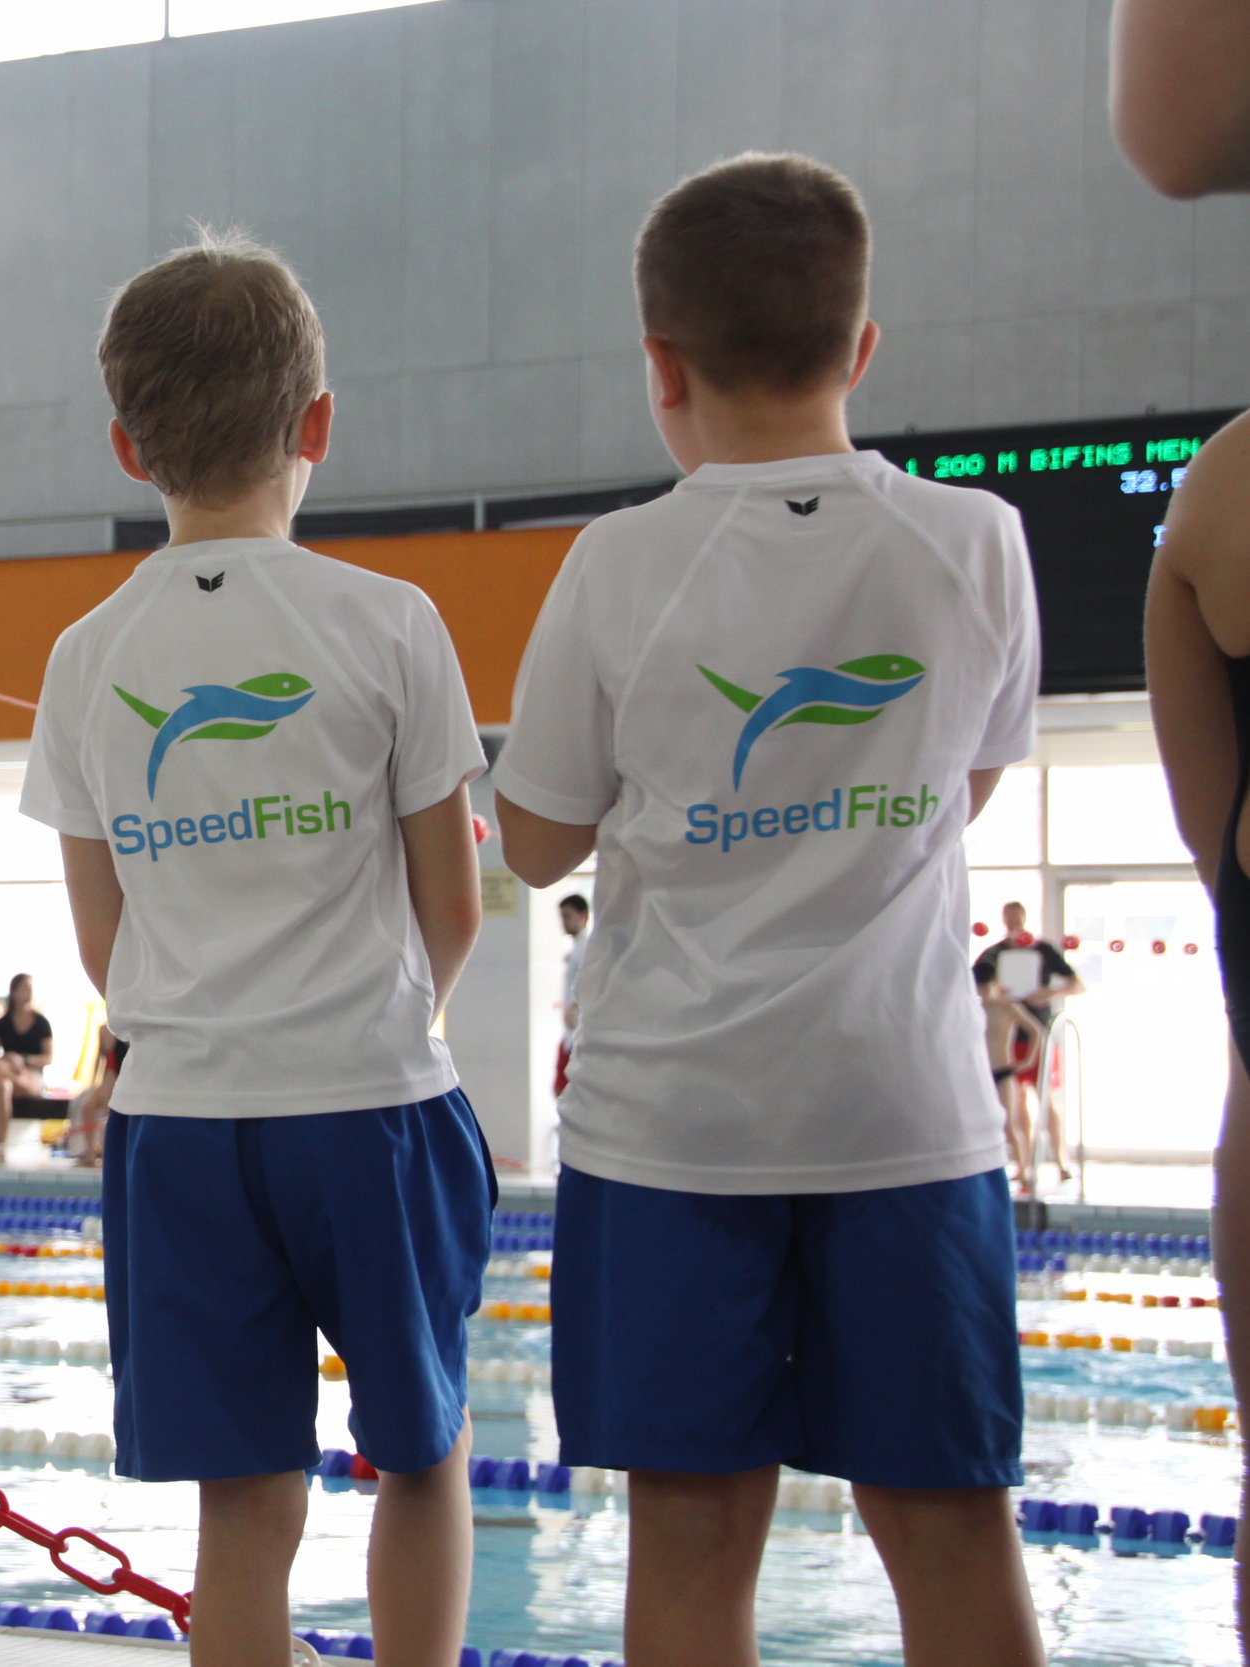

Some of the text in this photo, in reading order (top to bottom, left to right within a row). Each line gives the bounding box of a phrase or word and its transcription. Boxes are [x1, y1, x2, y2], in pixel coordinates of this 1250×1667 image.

[934, 453, 986, 478] 200
[997, 451, 1018, 474] M
[1030, 442, 1133, 471] BIFINS
[1146, 437, 1202, 462] MEN
[111, 791, 351, 862] SpeedFish
[685, 784, 939, 852] SpeedFish
